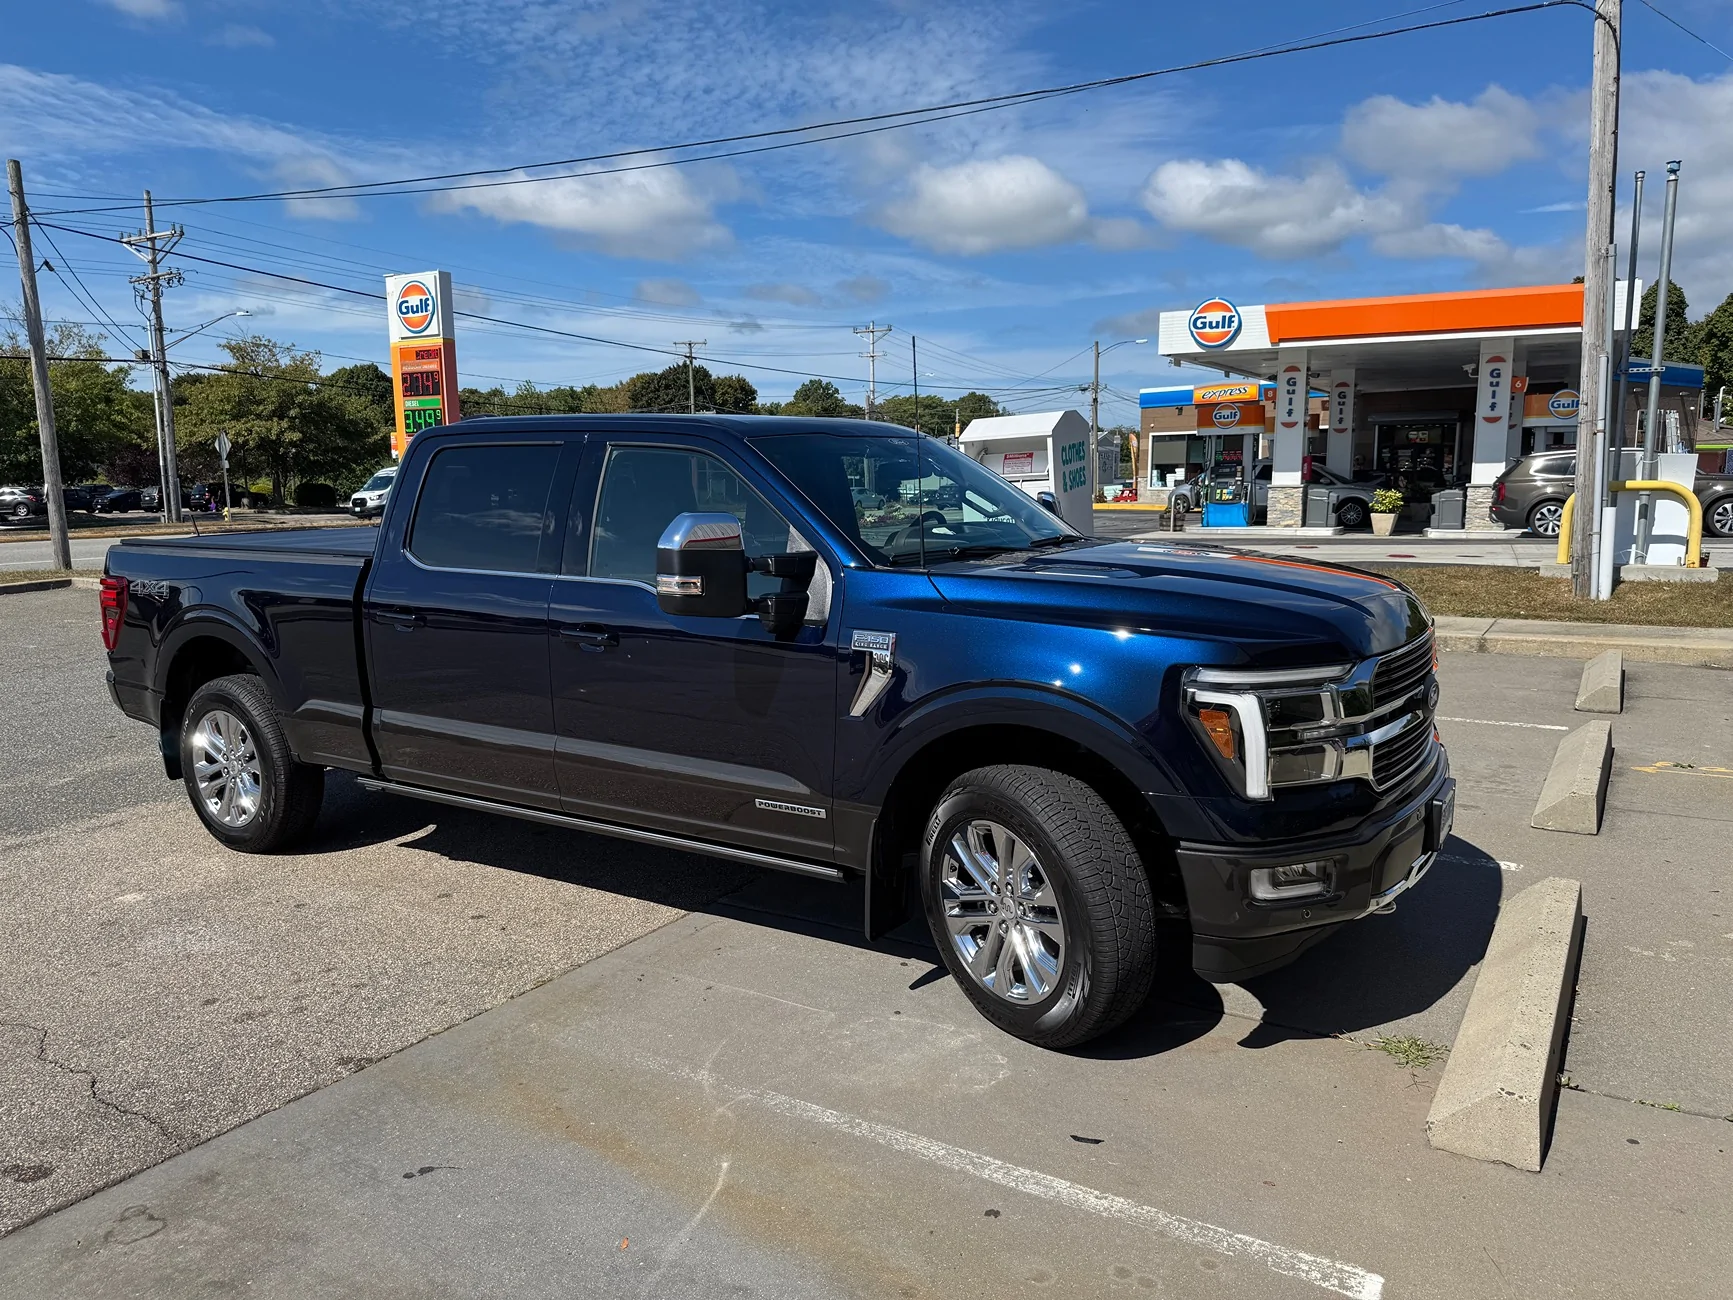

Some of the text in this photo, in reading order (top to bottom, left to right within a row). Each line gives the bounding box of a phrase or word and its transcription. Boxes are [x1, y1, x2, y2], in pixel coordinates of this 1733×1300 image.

[398, 297, 430, 316] Gulf
[1192, 314, 1236, 330] Gulf
[1202, 386, 1248, 400] express
[1286, 377, 1297, 417] Gulf
[1489, 368, 1501, 411] Gulf
[405, 400, 420, 408] DIESEL
[1337, 391, 1347, 424] Gulf
[1213, 411, 1238, 420] Gulf
[1061, 440, 1086, 467] CLOTHES
[1063, 465, 1087, 493] & SHOES
[854, 634, 889, 644] F-150
[757, 801, 822, 816] POWERBOOST
